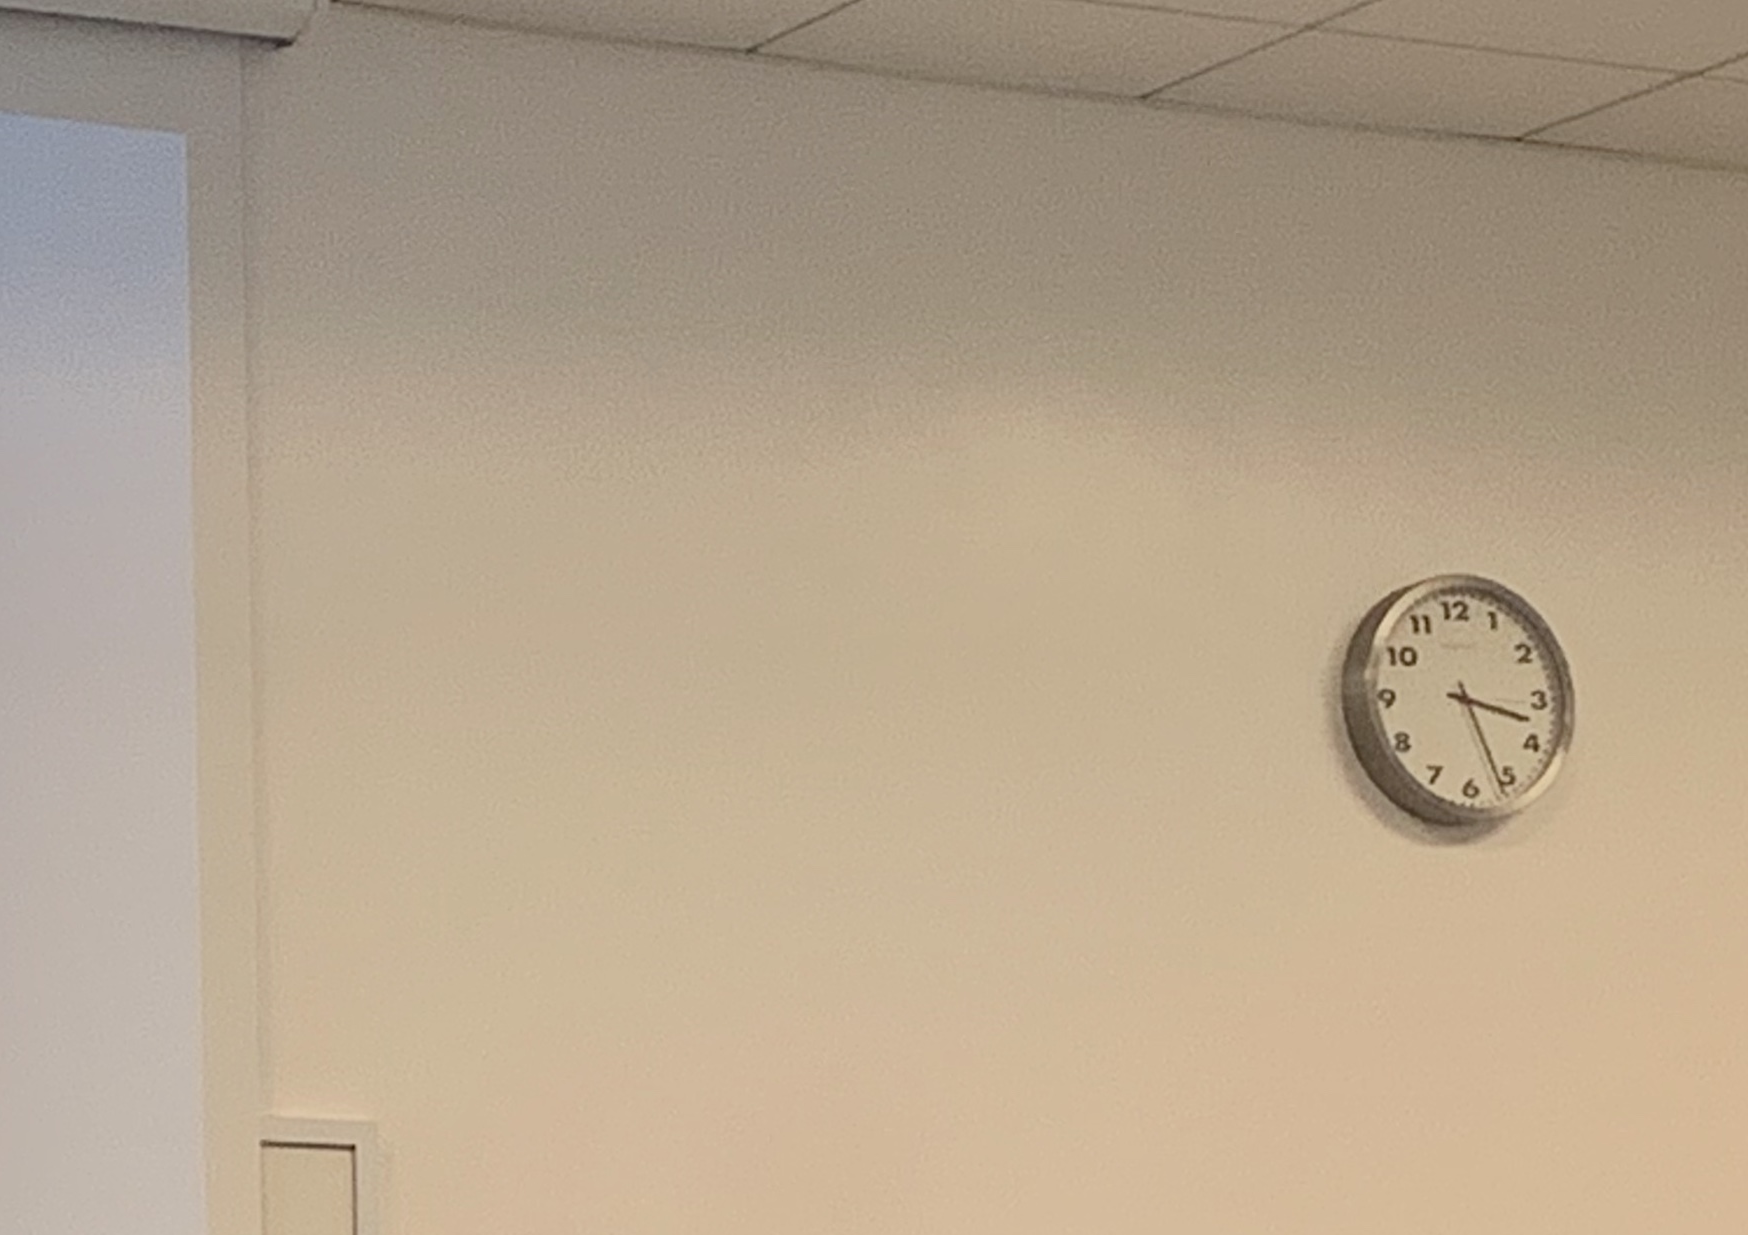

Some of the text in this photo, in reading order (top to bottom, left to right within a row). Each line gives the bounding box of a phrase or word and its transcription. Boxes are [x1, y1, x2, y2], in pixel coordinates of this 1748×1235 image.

[1440, 600, 1470, 622] 12
[1487, 611, 1499, 631] 1
[1410, 614, 1432, 635] 11
[1387, 646, 1418, 667] 10
[1515, 643, 1533, 664] 2
[1377, 688, 1396, 709] 9
[1530, 689, 1548, 711] 3
[1394, 731, 1412, 753] 8
[1523, 733, 1540, 753] 4
[1426, 764, 1444, 785] 7
[1500, 766, 1516, 787] 5
[1462, 778, 1480, 799] 6
